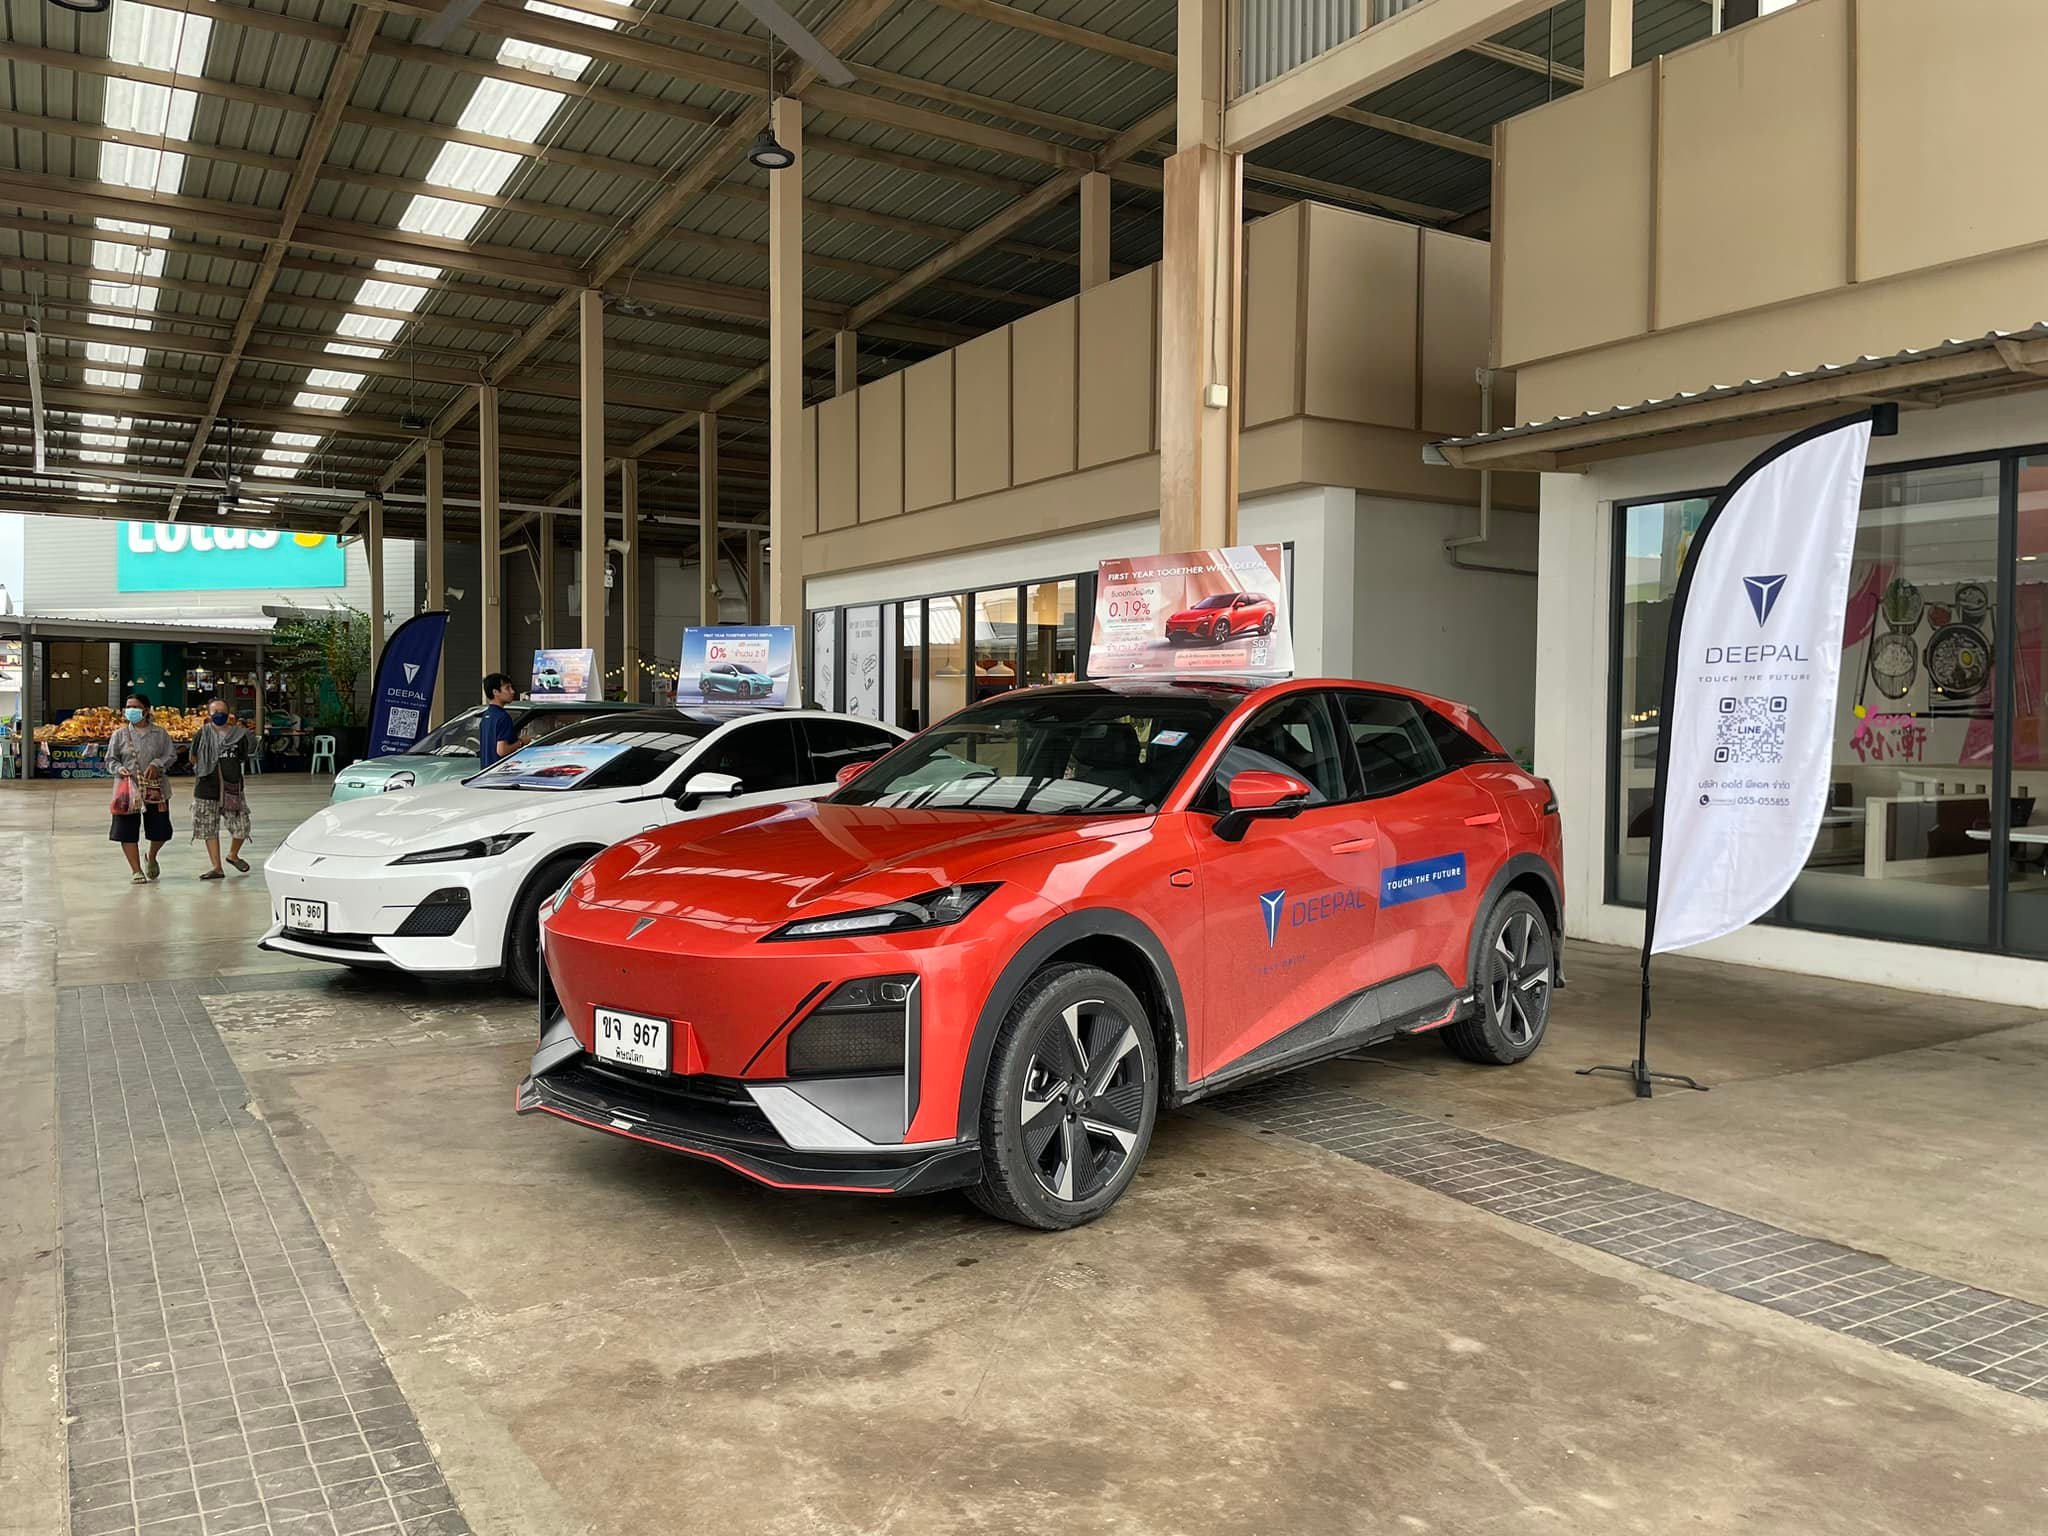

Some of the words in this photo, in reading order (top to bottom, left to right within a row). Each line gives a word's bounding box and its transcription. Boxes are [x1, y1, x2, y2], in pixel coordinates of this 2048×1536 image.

[1108, 572, 1129, 581] FIRST
[1131, 569, 1154, 579] YEAR
[1157, 565, 1204, 577] TOGETHER
[1109, 600, 1151, 617] 0.19%
[710, 646, 727, 659] 0%
[1705, 645, 1809, 664] DEEPAL
[387, 687, 427, 701] DEEPAL
[1738, 726, 1762, 734] LINE
[1387, 877, 1413, 890] TOUCH
[1415, 873, 1430, 884] THE
[1432, 867, 1461, 880] FUTURE
[307, 905, 320, 918] 960
[1291, 887, 1366, 928] DEEPAL
[602, 1016, 621, 1041] ขจ
[633, 1022, 659, 1048] 967
[615, 1046, 644, 1064] พิษณุโลก
